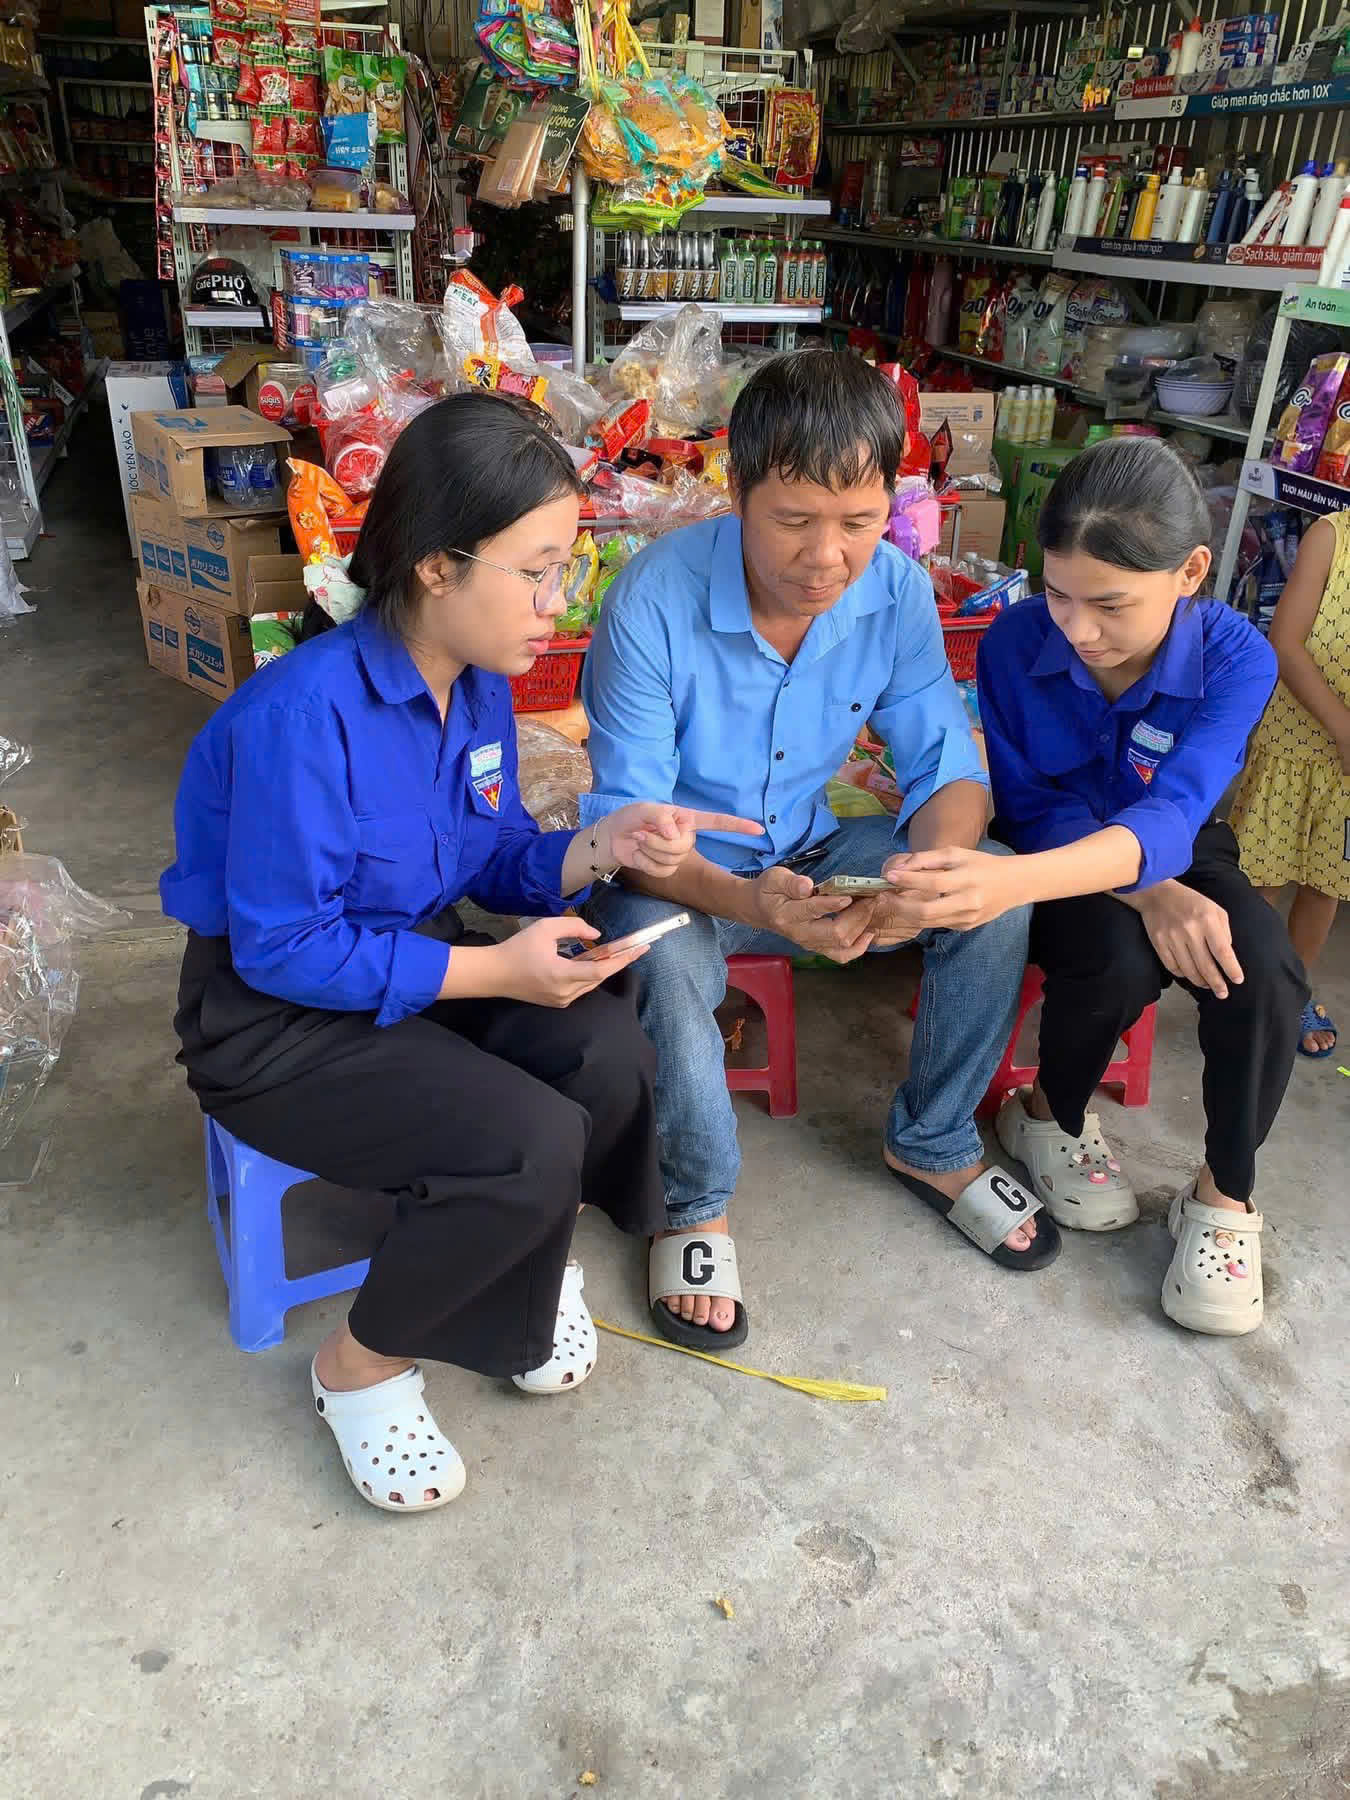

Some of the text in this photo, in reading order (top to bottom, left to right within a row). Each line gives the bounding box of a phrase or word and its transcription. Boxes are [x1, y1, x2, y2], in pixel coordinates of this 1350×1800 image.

[1211, 95, 1228, 110] Giúp
[1230, 95, 1247, 106] men
[1248, 91, 1268, 107] răng
[1270, 84, 1290, 103] chắc
[1292, 87, 1310, 101] hơn
[1305, 297, 1316, 309] An
[1318, 298, 1337, 312] toàn
[989, 1175, 1028, 1214] G
[682, 1240, 716, 1287] G
